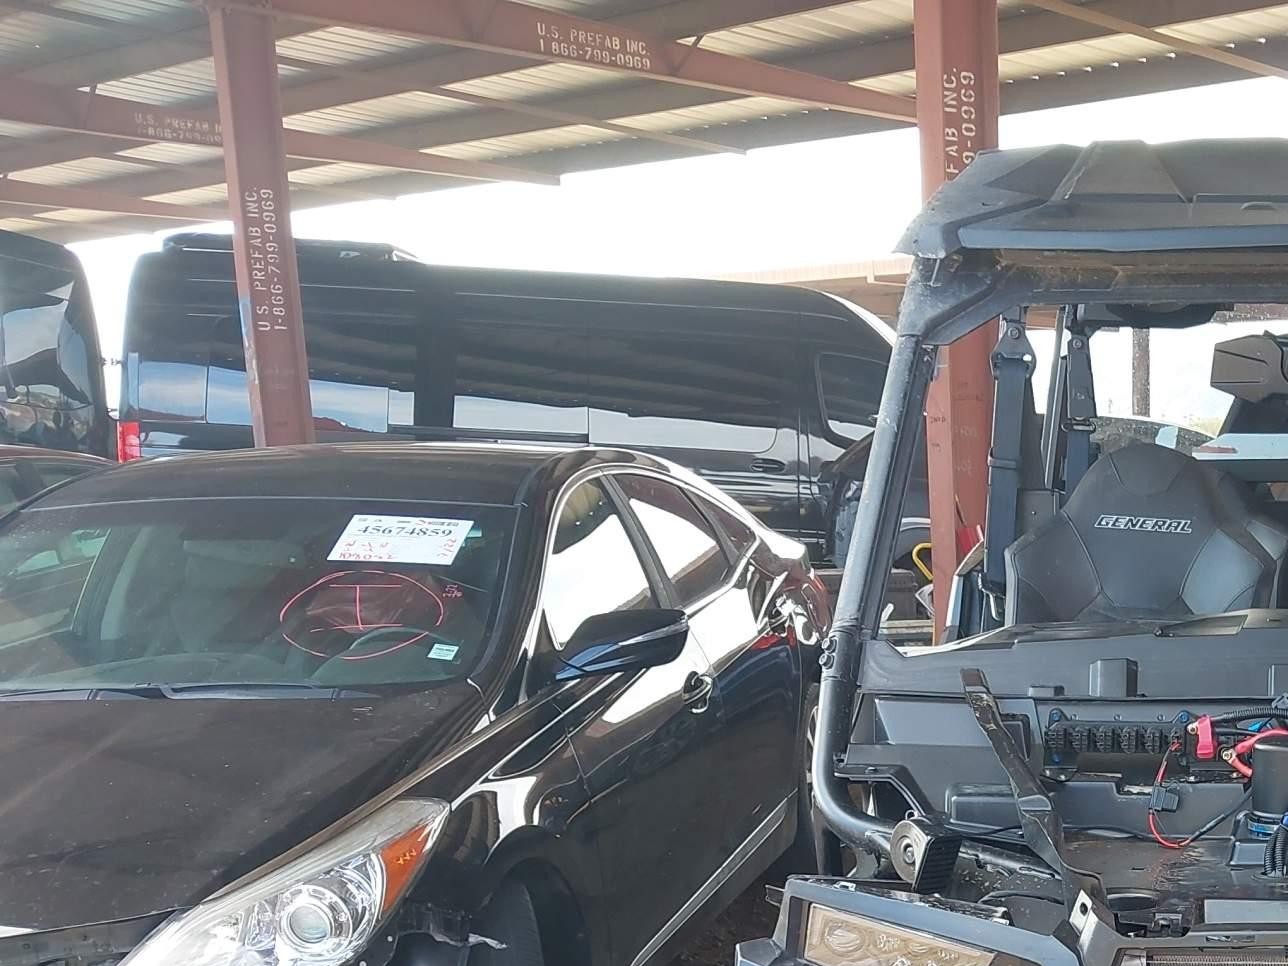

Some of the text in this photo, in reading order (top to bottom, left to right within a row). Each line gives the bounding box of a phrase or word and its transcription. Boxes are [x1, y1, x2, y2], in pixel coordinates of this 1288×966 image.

[537, 22, 650, 56] U.S. PREFAB INC.
[551, 42, 651, 69] 866-799-0969
[943, 68, 959, 113] INC.
[244, 187, 259, 218] INC.
[248, 226, 266, 290] PREFAB
[260, 188, 288, 330] 1-866-799-0969
[357, 525, 452, 537] 45674859
[1094, 514, 1192, 533] GENERAL
